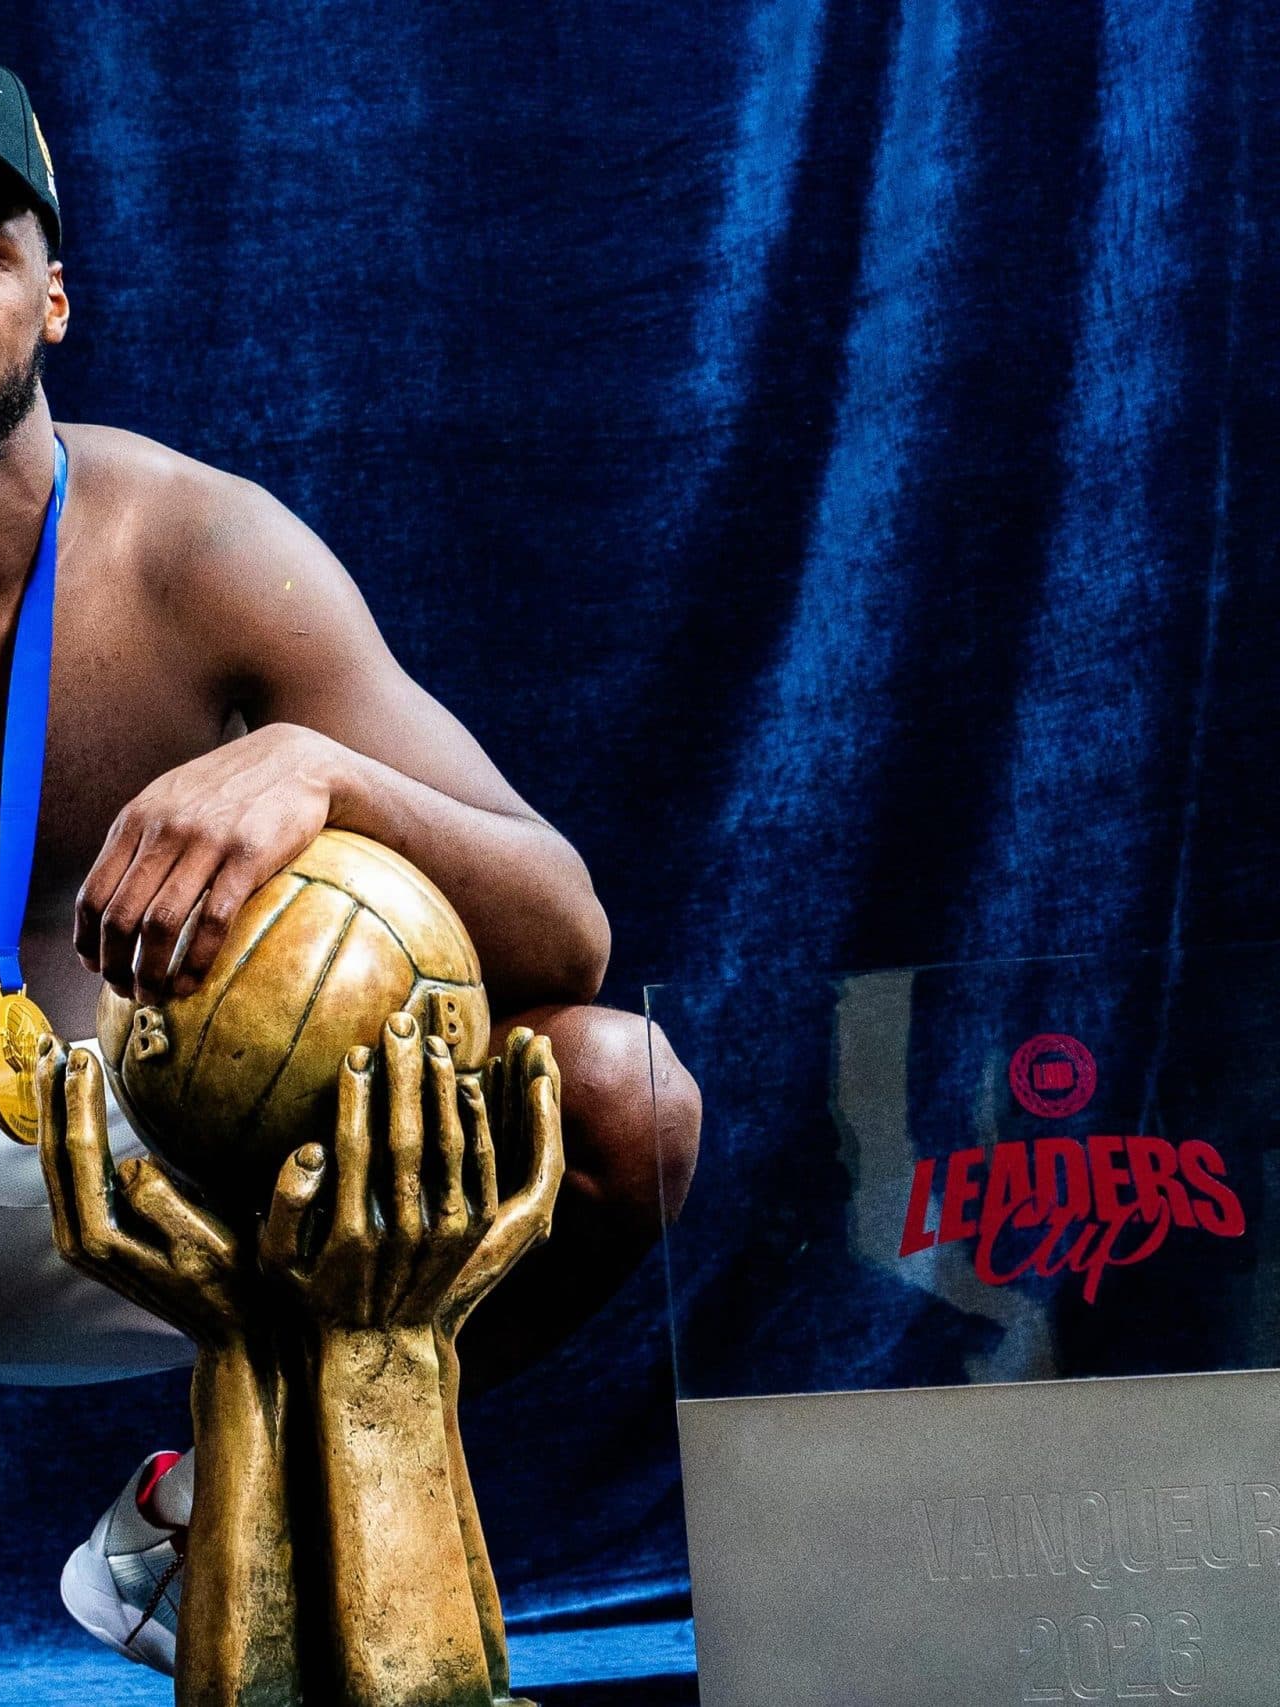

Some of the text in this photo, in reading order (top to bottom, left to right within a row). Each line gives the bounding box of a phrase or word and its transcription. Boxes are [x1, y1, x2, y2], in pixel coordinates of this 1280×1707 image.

[133, 1006, 168, 1060] B
[898, 1135, 1246, 1258] LEADERS
[974, 1195, 1170, 1304] Cup
[918, 1483, 1280, 1589] VAINQUEUR
[1019, 1610, 1206, 1701] 2026
